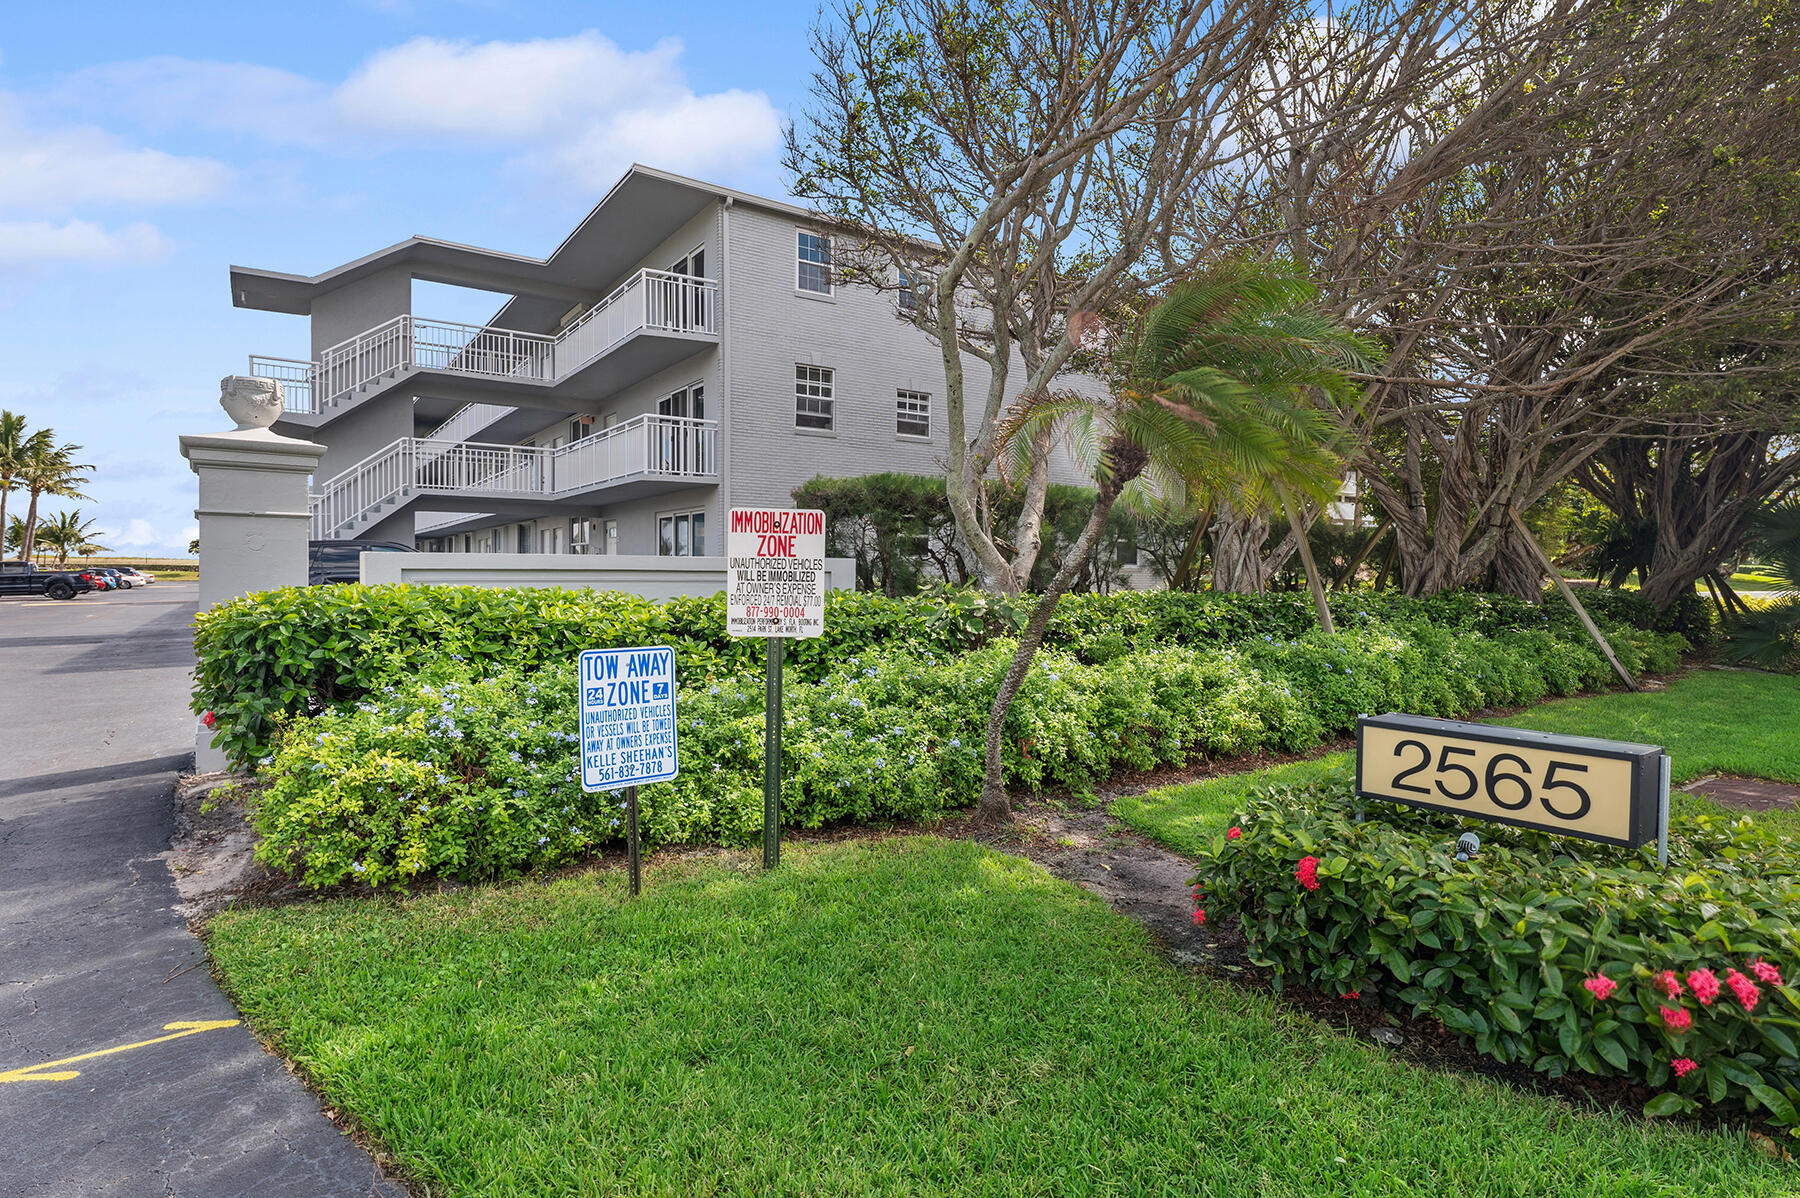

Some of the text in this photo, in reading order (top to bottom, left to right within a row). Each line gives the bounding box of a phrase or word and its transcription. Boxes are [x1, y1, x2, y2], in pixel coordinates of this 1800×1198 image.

[731, 511, 823, 535] IMMOBILIZATION
[757, 535, 797, 558] ZONE
[730, 557, 823, 571] UNAUTHORIZED VEHICLES
[737, 570, 816, 583] WILL BE IMMOBILIZED
[736, 582, 817, 595] AT OWNER'S EXPENSE
[731, 594, 762, 606] ENFORCED
[746, 606, 806, 618] 877-990-0004
[585, 652, 670, 681] TOW AWAY
[588, 689, 603, 701] 24
[607, 680, 651, 707] ZONE
[657, 684, 665, 695] 7
[586, 704, 671, 725] UNAUTHORIZED VEHICLES
[586, 718, 672, 739] OR VESSELS WILL BE TOWED
[587, 731, 672, 753] AWAY AT OWNERS EXPENSE
[587, 746, 673, 769] KELLE SHEEHAN'S
[600, 761, 663, 782] 561-832-7878
[1391, 740, 1591, 820] 2565
